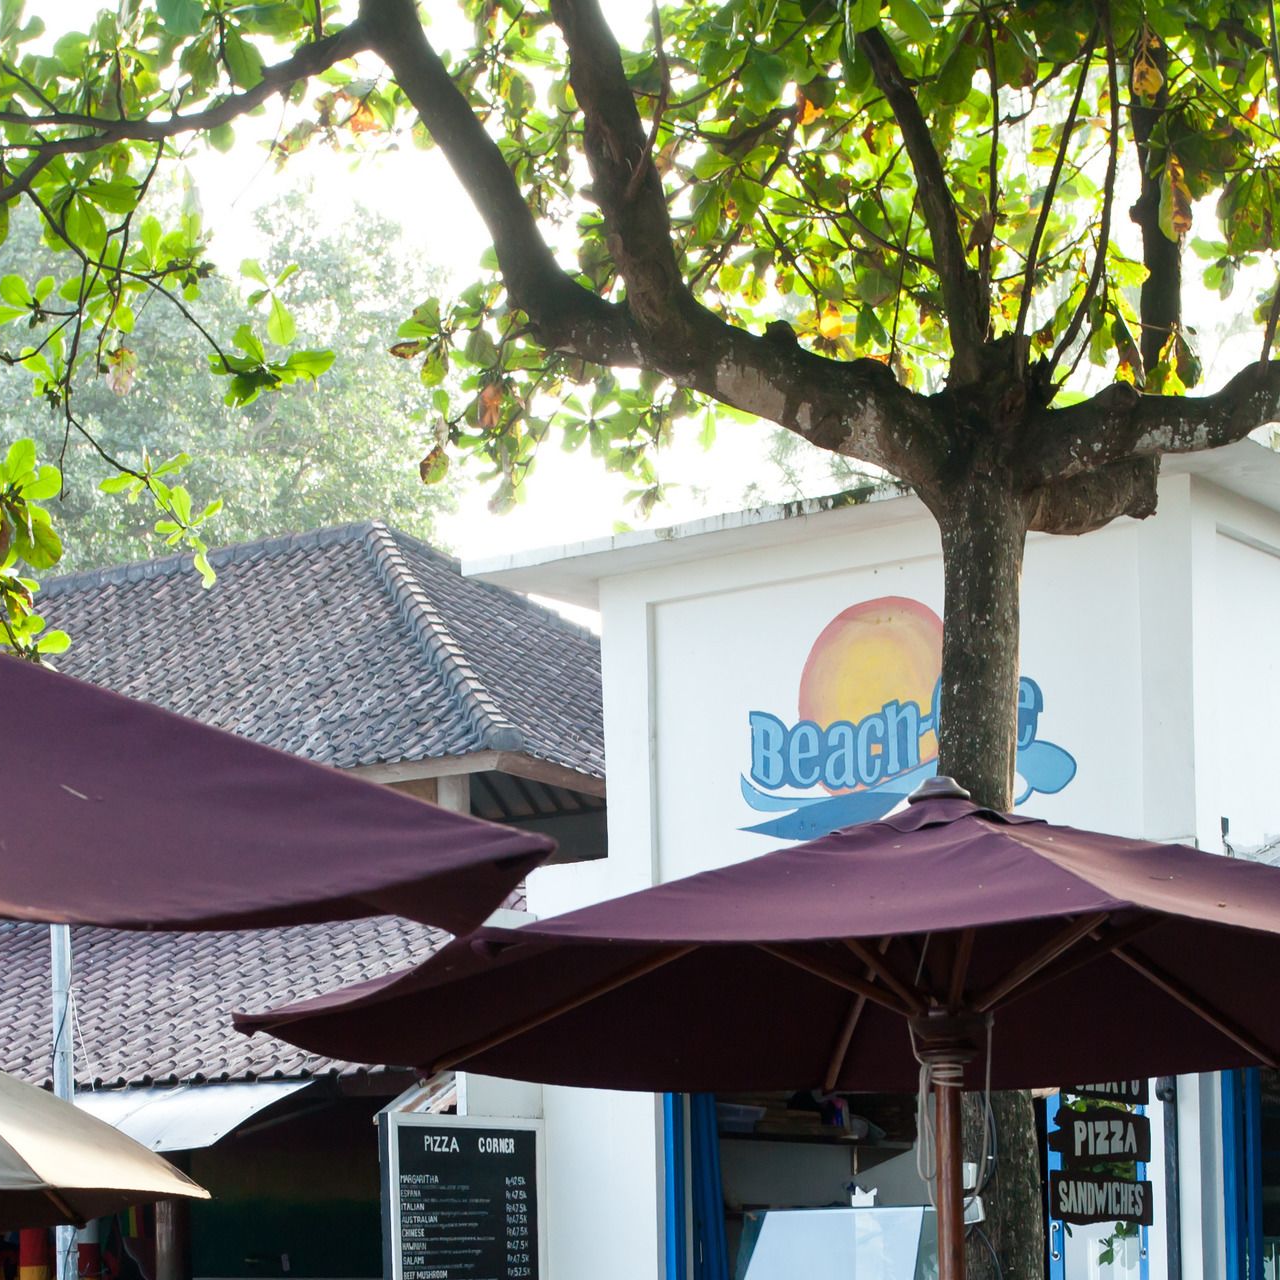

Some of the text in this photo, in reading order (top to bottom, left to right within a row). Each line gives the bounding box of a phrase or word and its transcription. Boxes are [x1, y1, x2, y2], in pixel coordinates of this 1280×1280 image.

[424, 1135, 515, 1153] PIZZA CORNER
[1074, 1120, 1137, 1156] PIZZA
[1058, 1180, 1144, 1216] SANDWICHES
[402, 1229, 424, 1237] CHINESE
[416, 1270, 448, 1279] MUSHROOM
